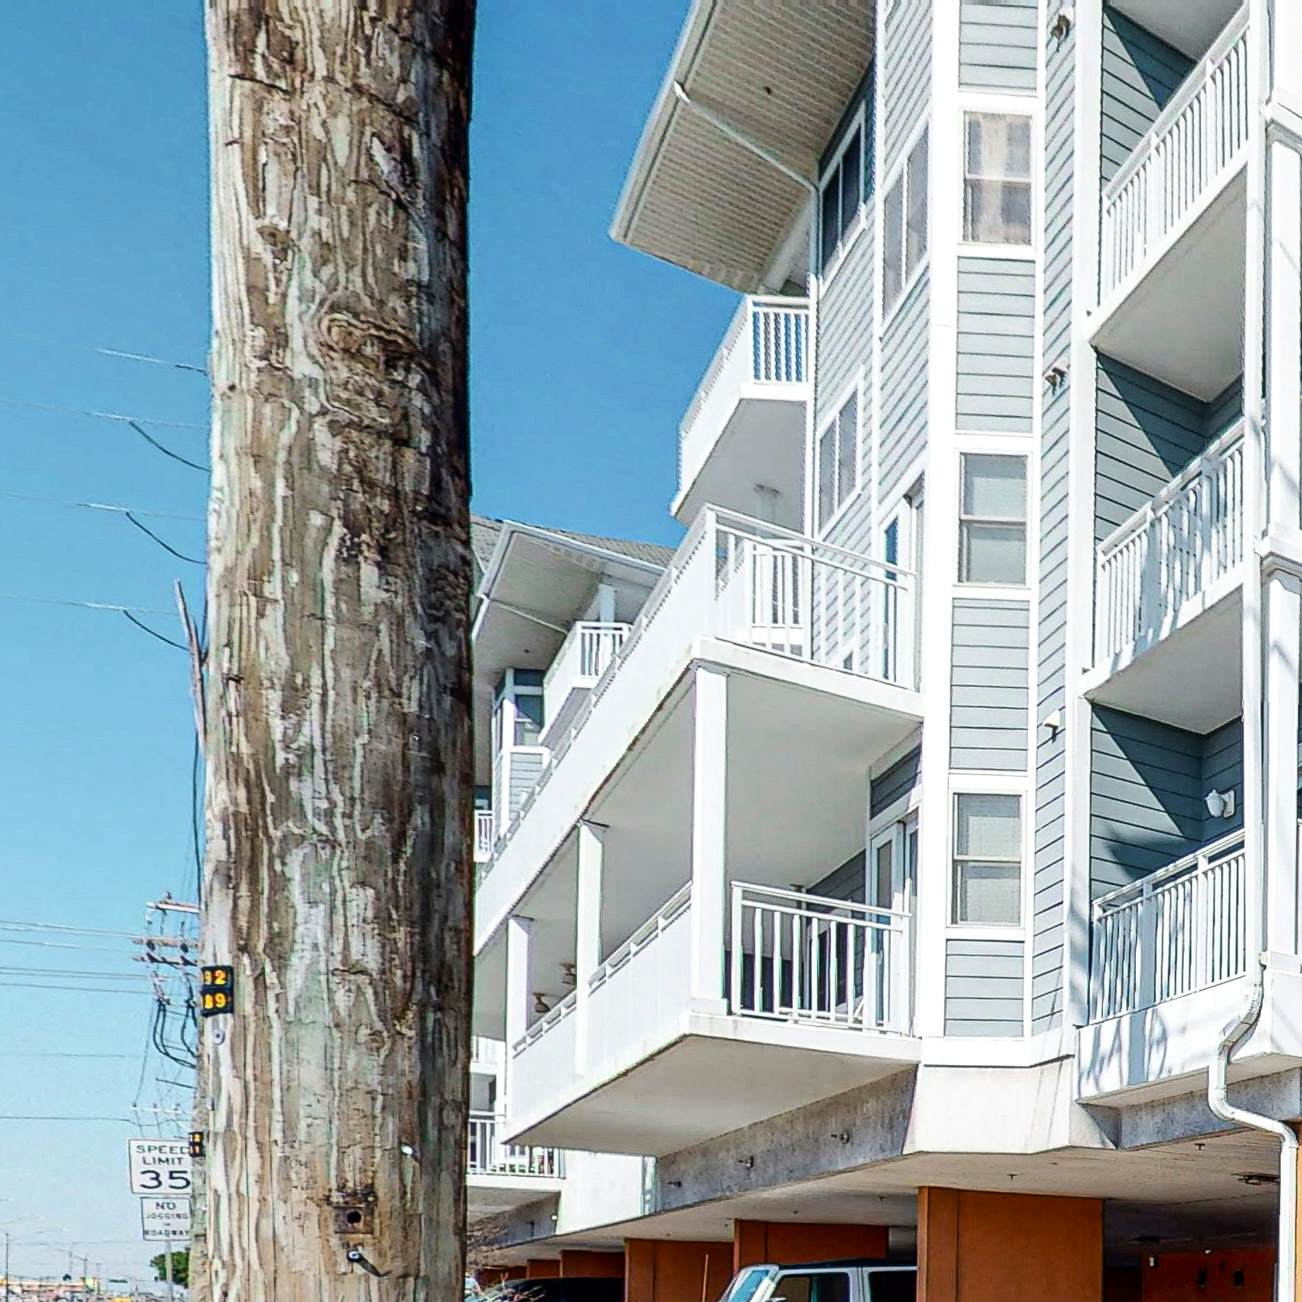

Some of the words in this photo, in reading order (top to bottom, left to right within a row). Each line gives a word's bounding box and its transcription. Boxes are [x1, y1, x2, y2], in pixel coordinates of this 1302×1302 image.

[142, 1157, 183, 1165] LIMIT
[140, 1170, 191, 1189] 35
[155, 1201, 176, 1211] NO
